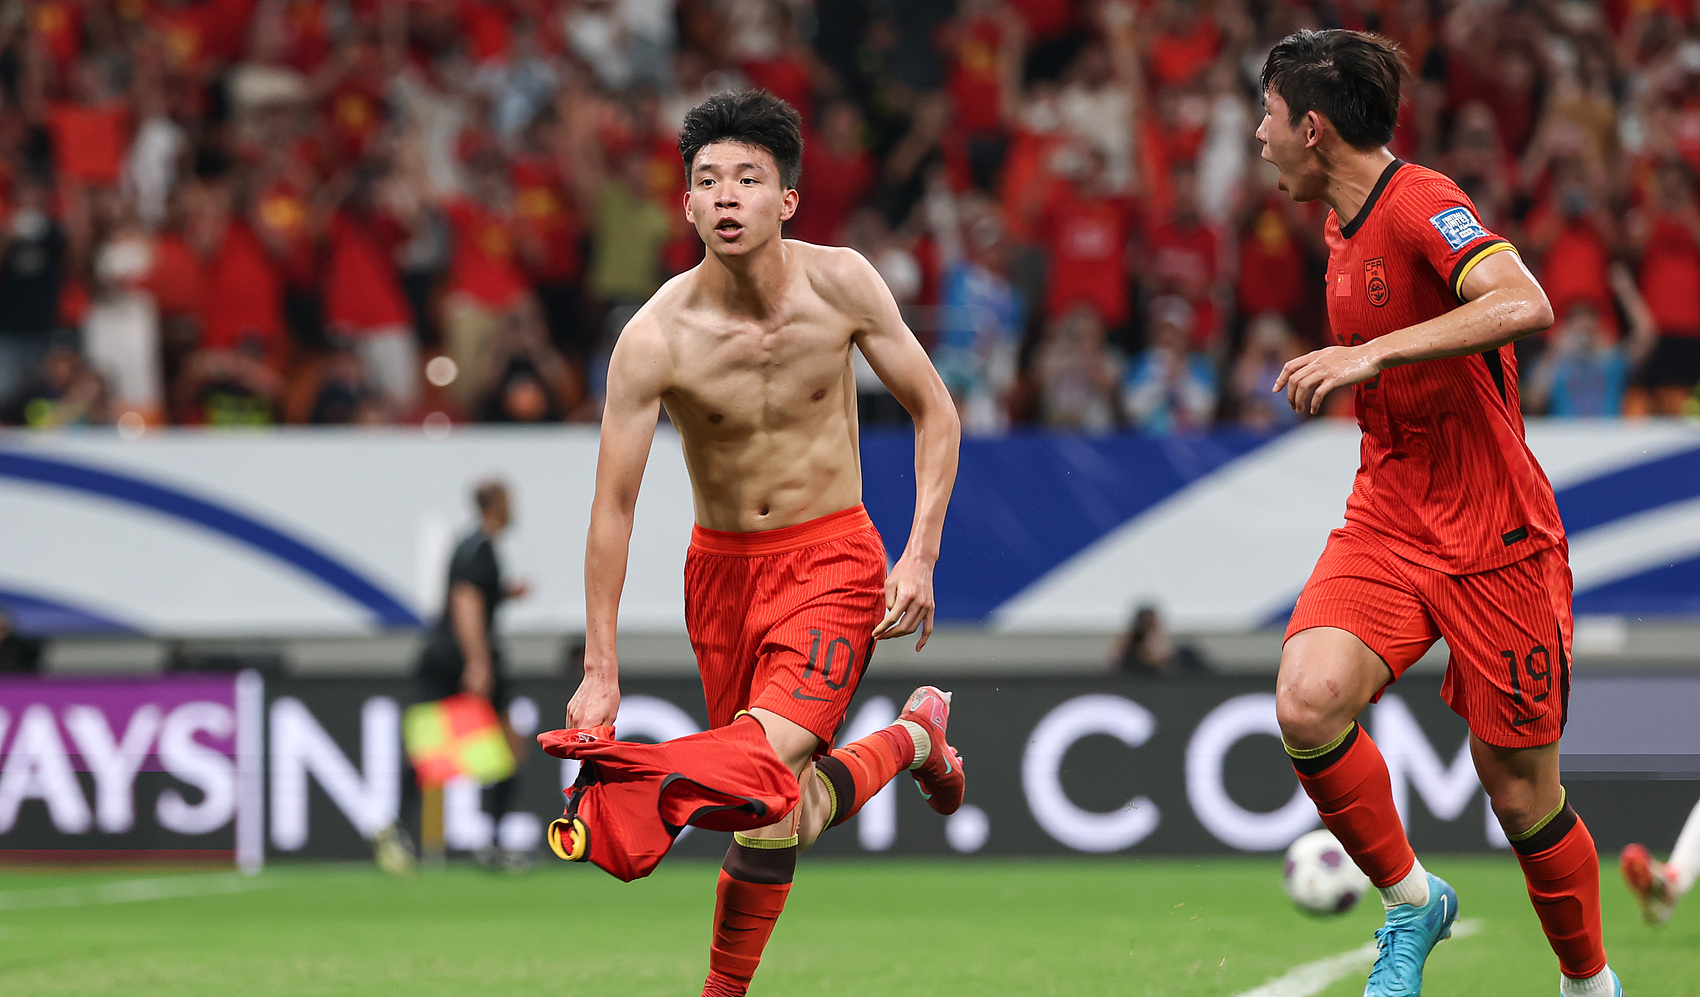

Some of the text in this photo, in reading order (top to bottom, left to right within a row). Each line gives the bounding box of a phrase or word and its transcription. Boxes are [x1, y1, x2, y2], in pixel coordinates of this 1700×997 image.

[1365, 260, 1383, 272] CFA
[802, 628, 855, 691] 10
[1501, 645, 1552, 705] 19
[0, 701, 236, 835] AYS
[270, 694, 1512, 852] N.COM
